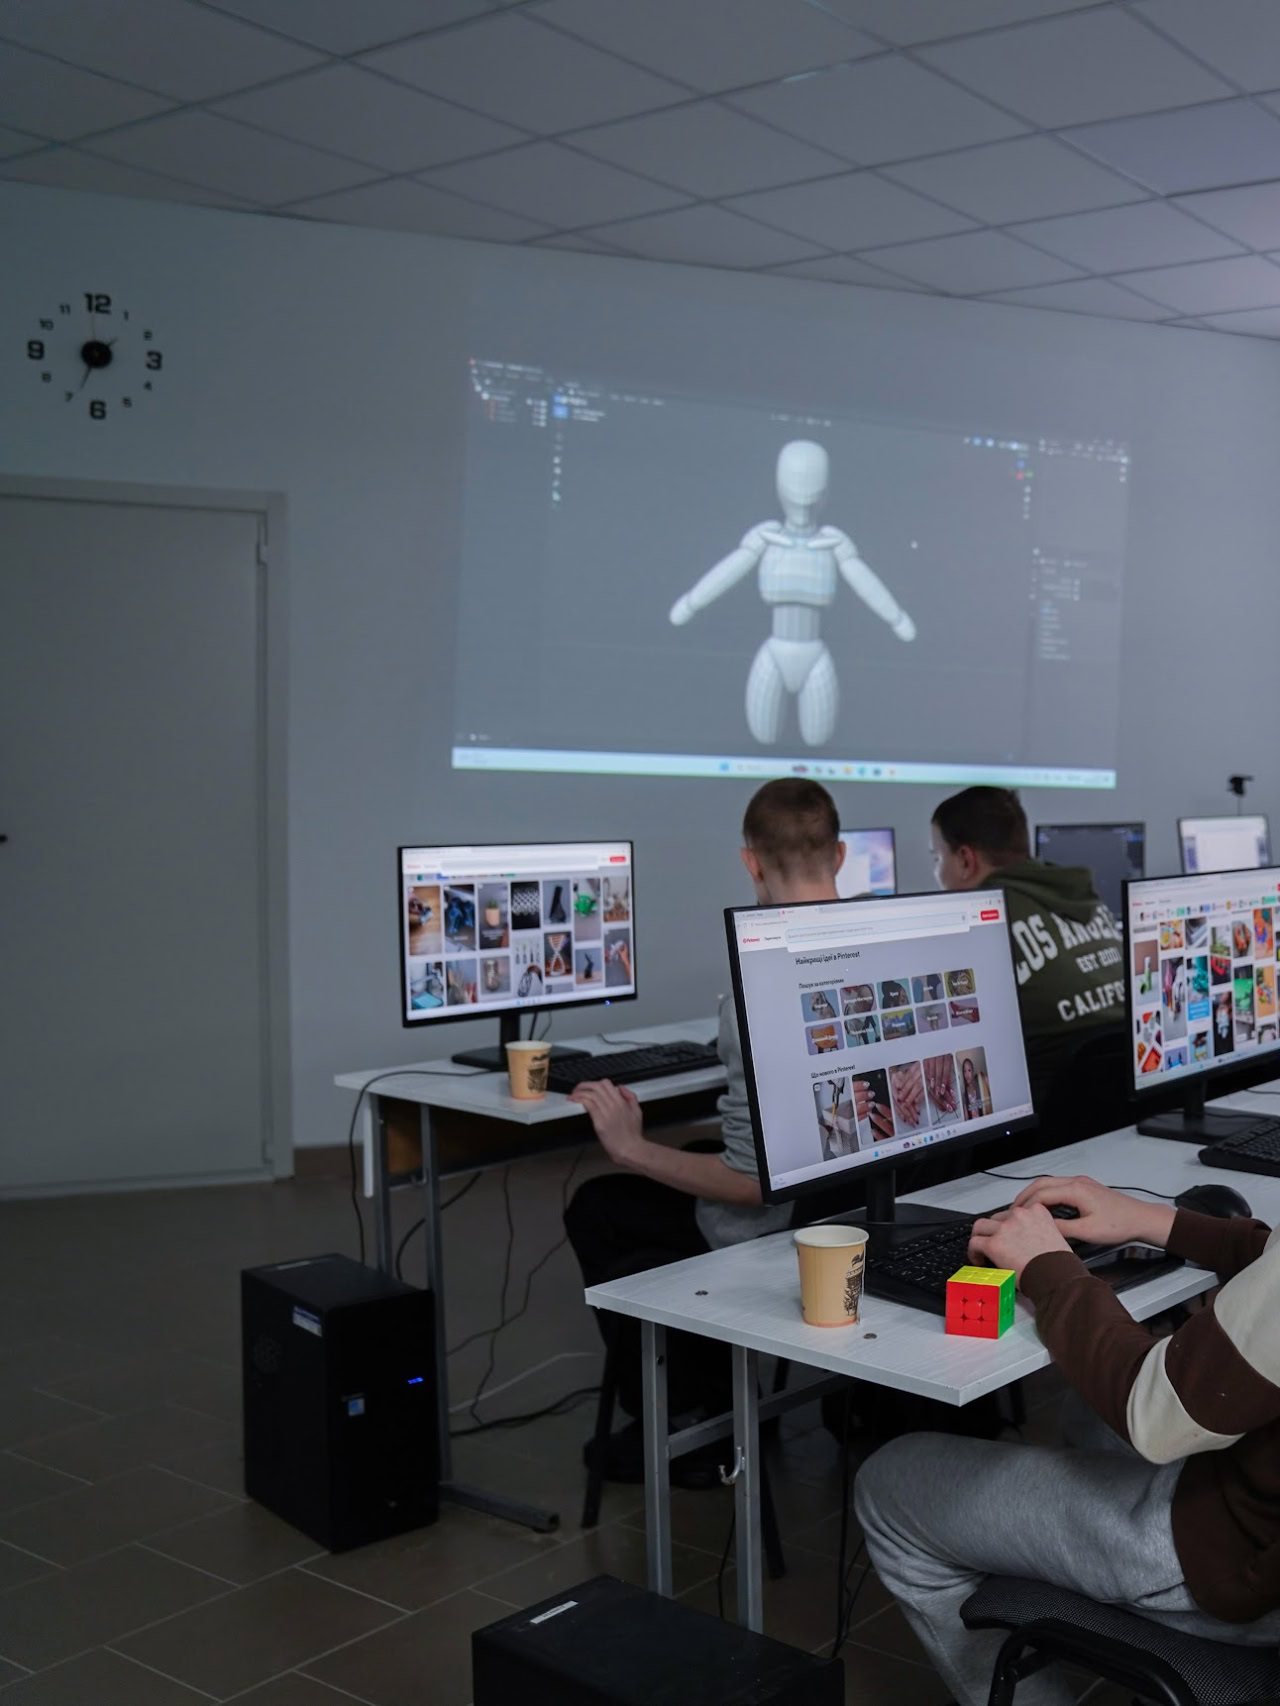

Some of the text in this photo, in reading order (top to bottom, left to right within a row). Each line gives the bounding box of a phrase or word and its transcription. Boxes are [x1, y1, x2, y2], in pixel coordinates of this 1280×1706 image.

[84, 293, 111, 314] 12
[27, 340, 45, 360] 9
[146, 350, 162, 370] 3
[89, 400, 107, 420] 6
